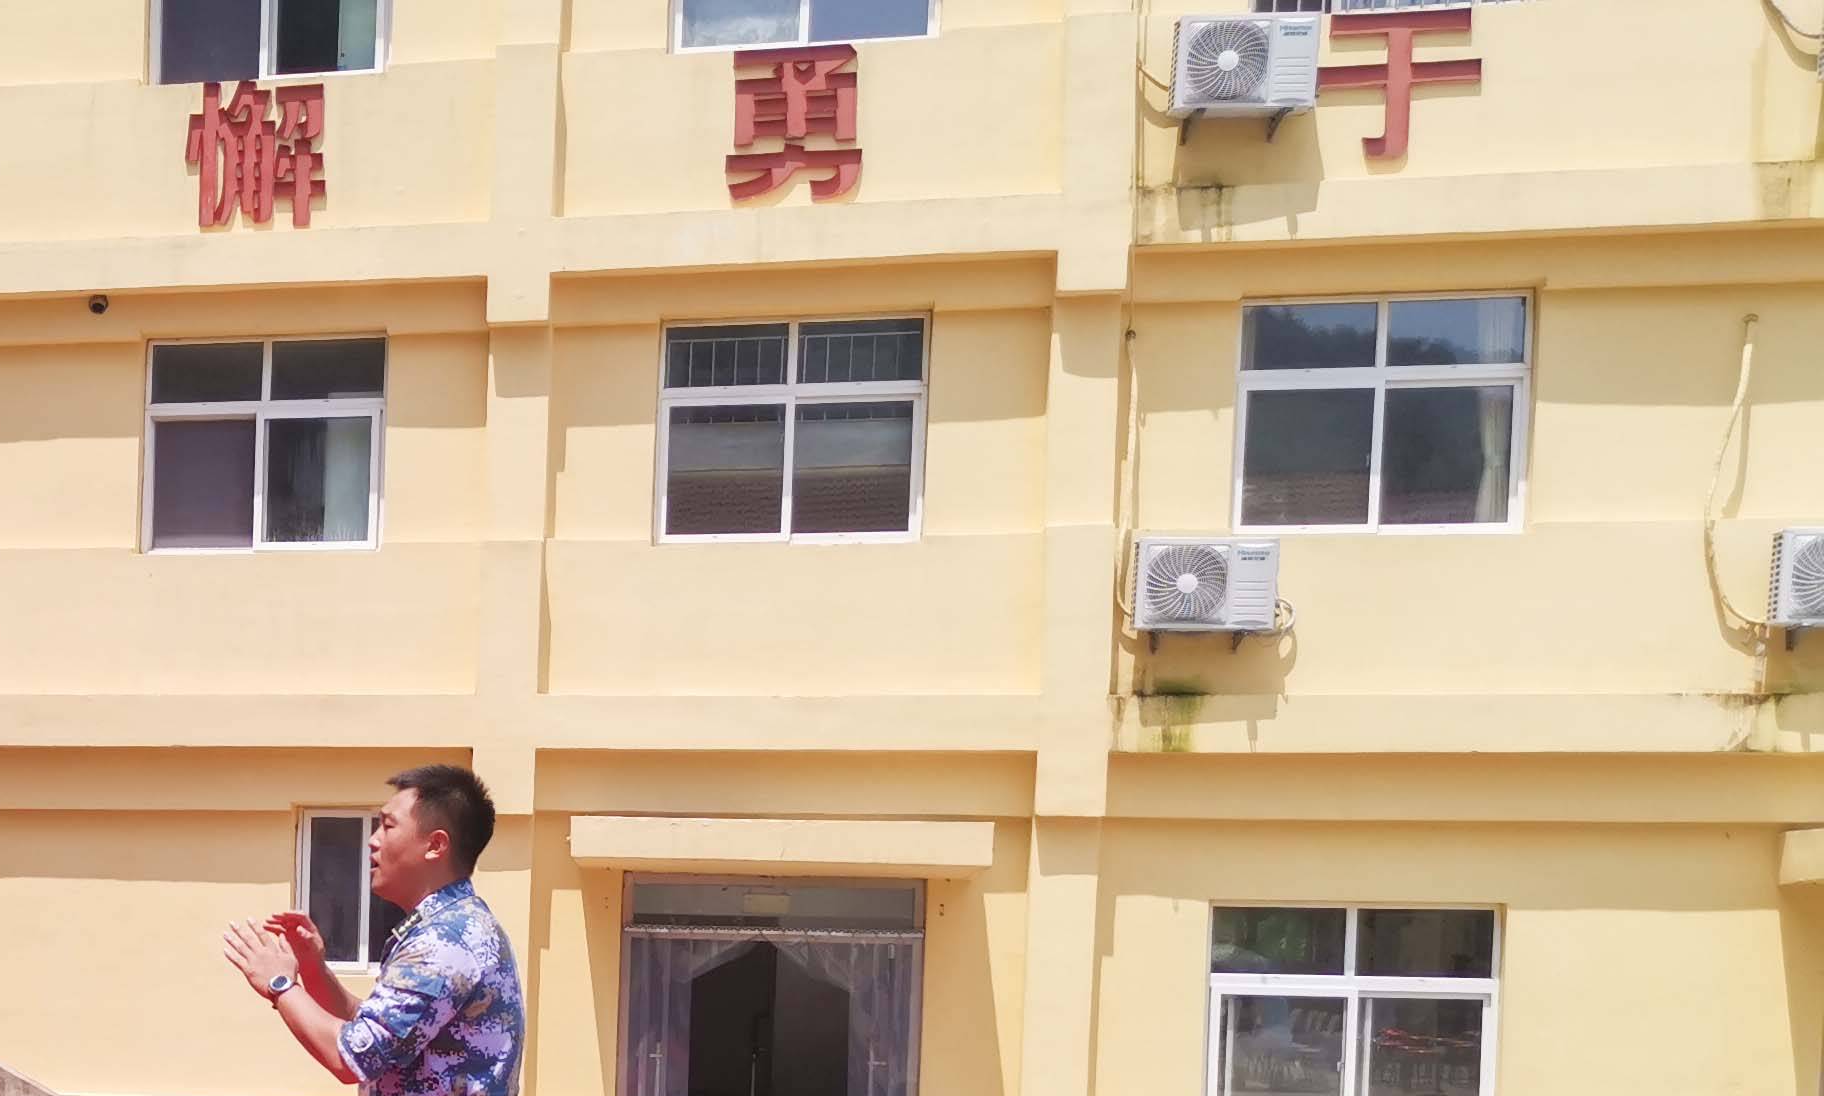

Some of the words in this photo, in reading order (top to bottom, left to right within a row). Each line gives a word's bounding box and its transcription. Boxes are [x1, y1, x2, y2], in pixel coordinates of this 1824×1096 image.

[185, 80, 326, 230] 懈
[725, 44, 863, 204] 勇
[1315, 8, 1482, 162] 于
